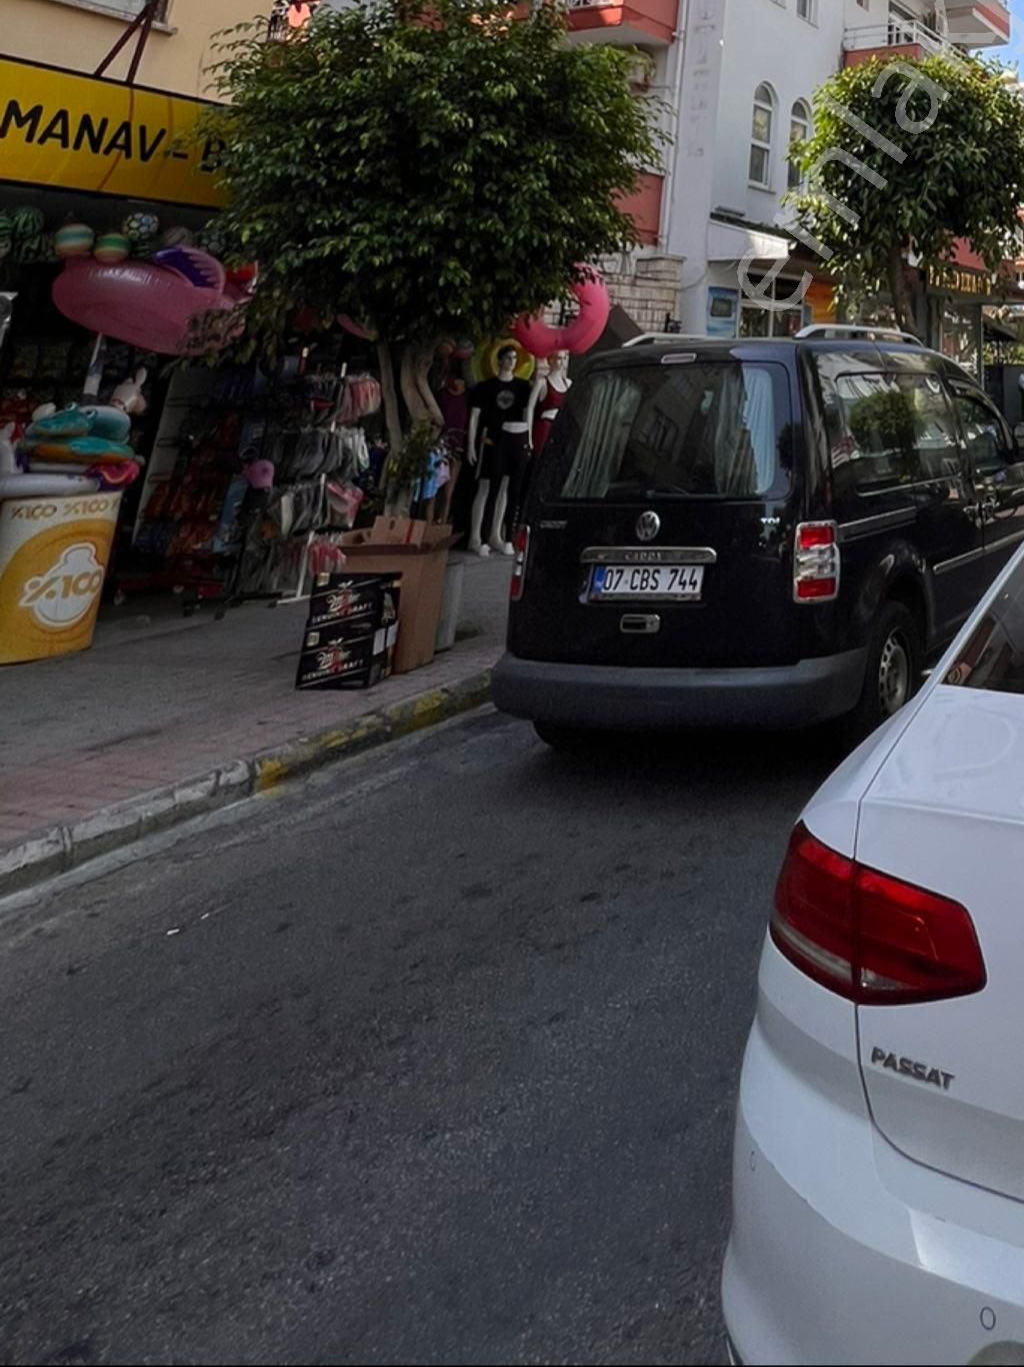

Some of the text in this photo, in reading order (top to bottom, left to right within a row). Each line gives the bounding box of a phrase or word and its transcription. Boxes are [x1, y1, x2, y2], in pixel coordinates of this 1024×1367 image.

[0, 99, 167, 163] MANAV
[603, 568, 699, 591] 07 CBS 744
[870, 1045, 956, 1091] PASSAT
